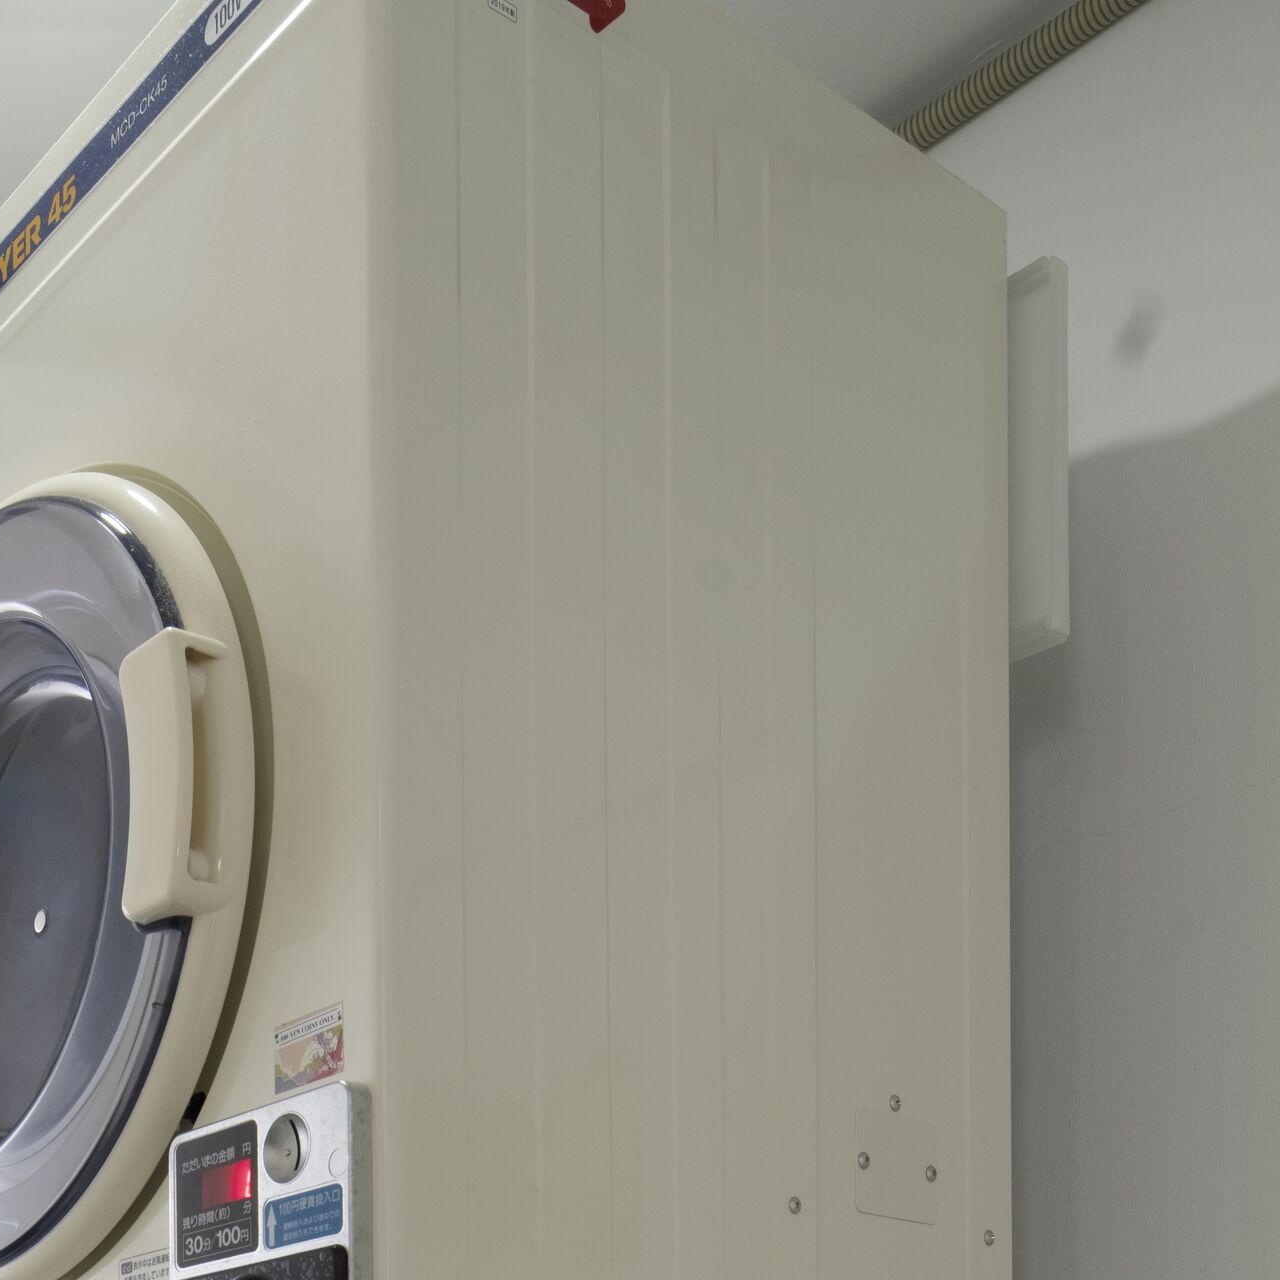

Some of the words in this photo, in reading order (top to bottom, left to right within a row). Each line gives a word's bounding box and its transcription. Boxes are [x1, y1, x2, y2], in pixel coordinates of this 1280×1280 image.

[47, 175, 77, 226] 45
[111, 74, 167, 148] MCD-CK45
[182, 1146, 235, 1174] ただいまの金額
[242, 1141, 251, 1155] 円
[243, 1201, 252, 1214] 分
